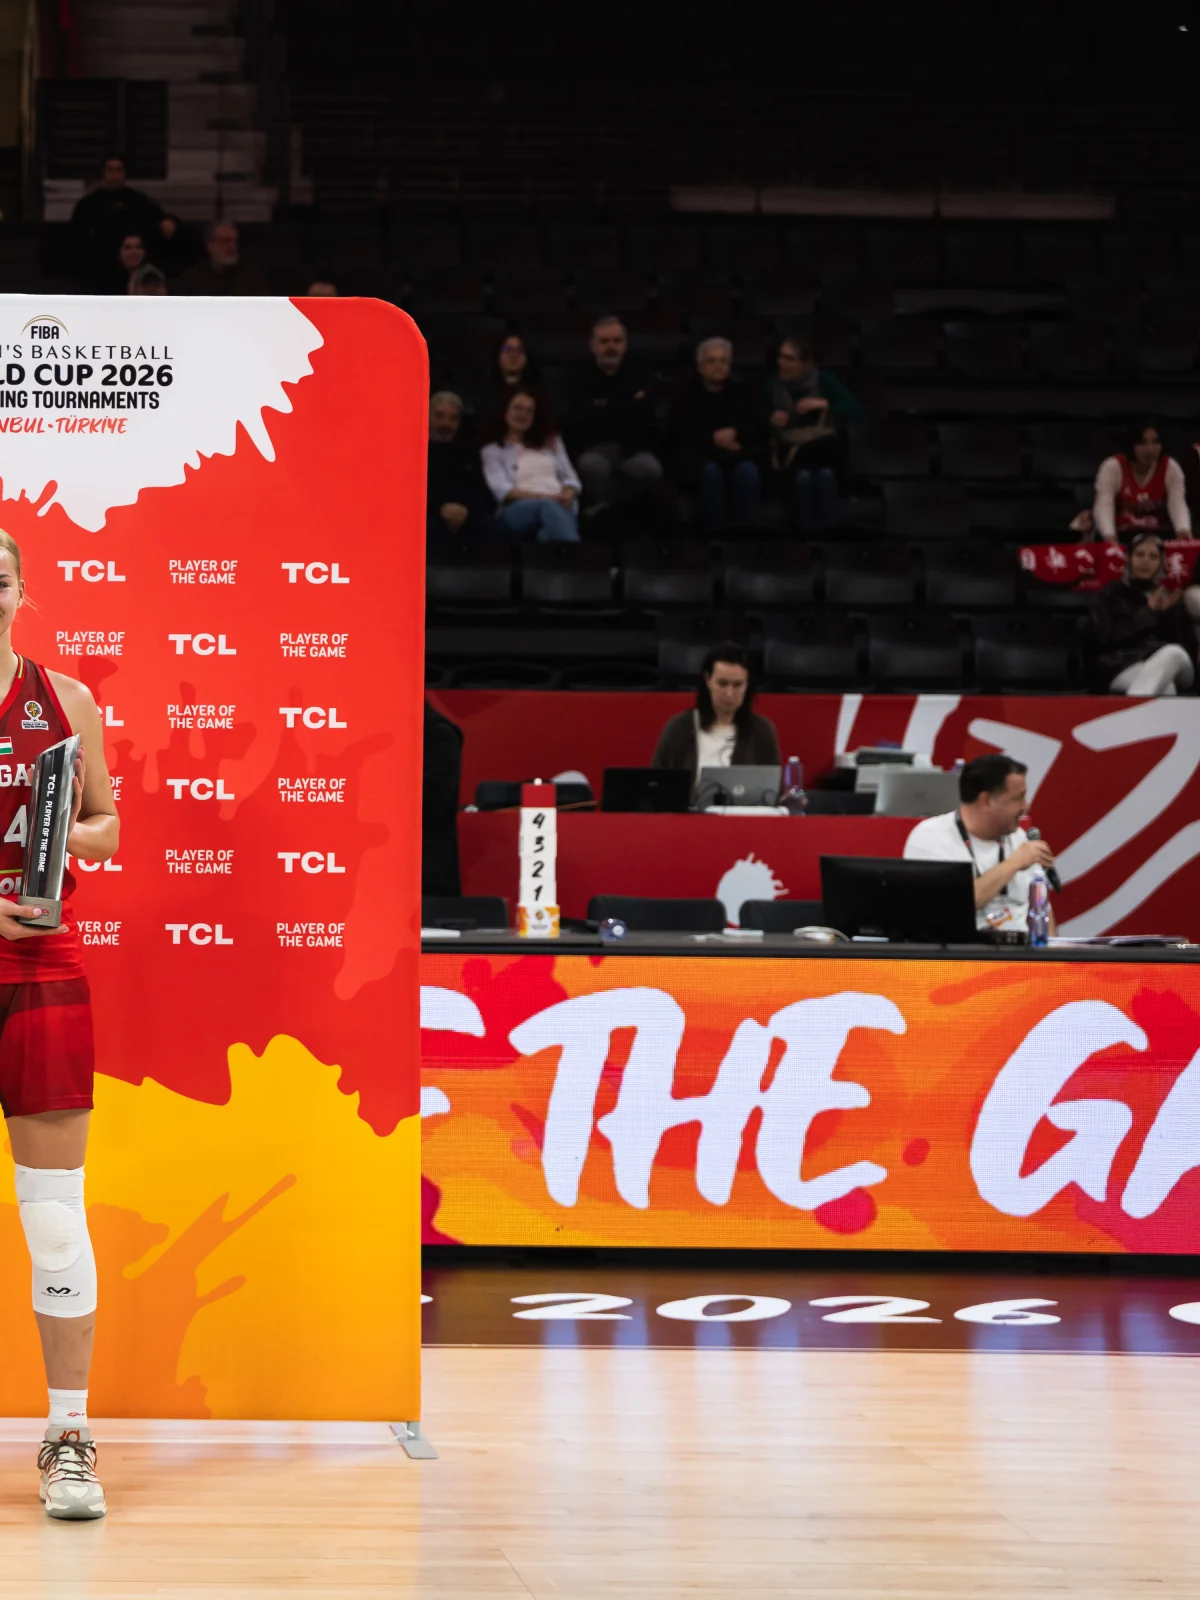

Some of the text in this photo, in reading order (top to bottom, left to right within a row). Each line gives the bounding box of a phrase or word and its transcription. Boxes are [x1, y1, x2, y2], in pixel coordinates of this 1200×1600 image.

[30, 325, 60, 340] FIBA
[31, 344, 174, 360] BASKETBALL
[33, 363, 94, 386] CUP
[101, 364, 173, 387] 2026
[32, 390, 160, 410] TOURNAMENTS
[57, 559, 126, 583] TCL
[169, 559, 238, 572] PLAYER OF
[281, 561, 350, 585] TCL
[170, 572, 236, 585] THE GAME
[56, 630, 125, 643] PLAYER OF
[279, 632, 349, 645] PLAYER OF
[57, 643, 123, 656] THE GAME
[168, 633, 237, 656] TCL
[281, 645, 346, 658] THE GAME
[167, 704, 236, 717] PLAYER OF
[279, 706, 348, 729] TCL
[168, 717, 234, 729] THE GAME
[166, 777, 235, 801] TCL
[277, 777, 347, 790] PLAYER OF
[279, 790, 345, 803] THE GAME
[37, 773, 56, 872] TCL PLAYER OF THE GAME
[532, 811, 546, 829] 4
[533, 835, 545, 853] 3
[165, 849, 234, 861] PLAYER OF
[277, 851, 346, 874] TCL
[167, 862, 232, 874] THE GAME
[531, 860, 545, 878] 2
[533, 884, 544, 902] 1
[104, 921, 122, 933] OF
[165, 922, 234, 946] TCL
[276, 922, 345, 935] PLAYER OF
[82, 933, 120, 946] GAME
[278, 935, 343, 947] THE GAME
[507, 985, 907, 1210] THE
[510, 1292, 1062, 1326] 2026
